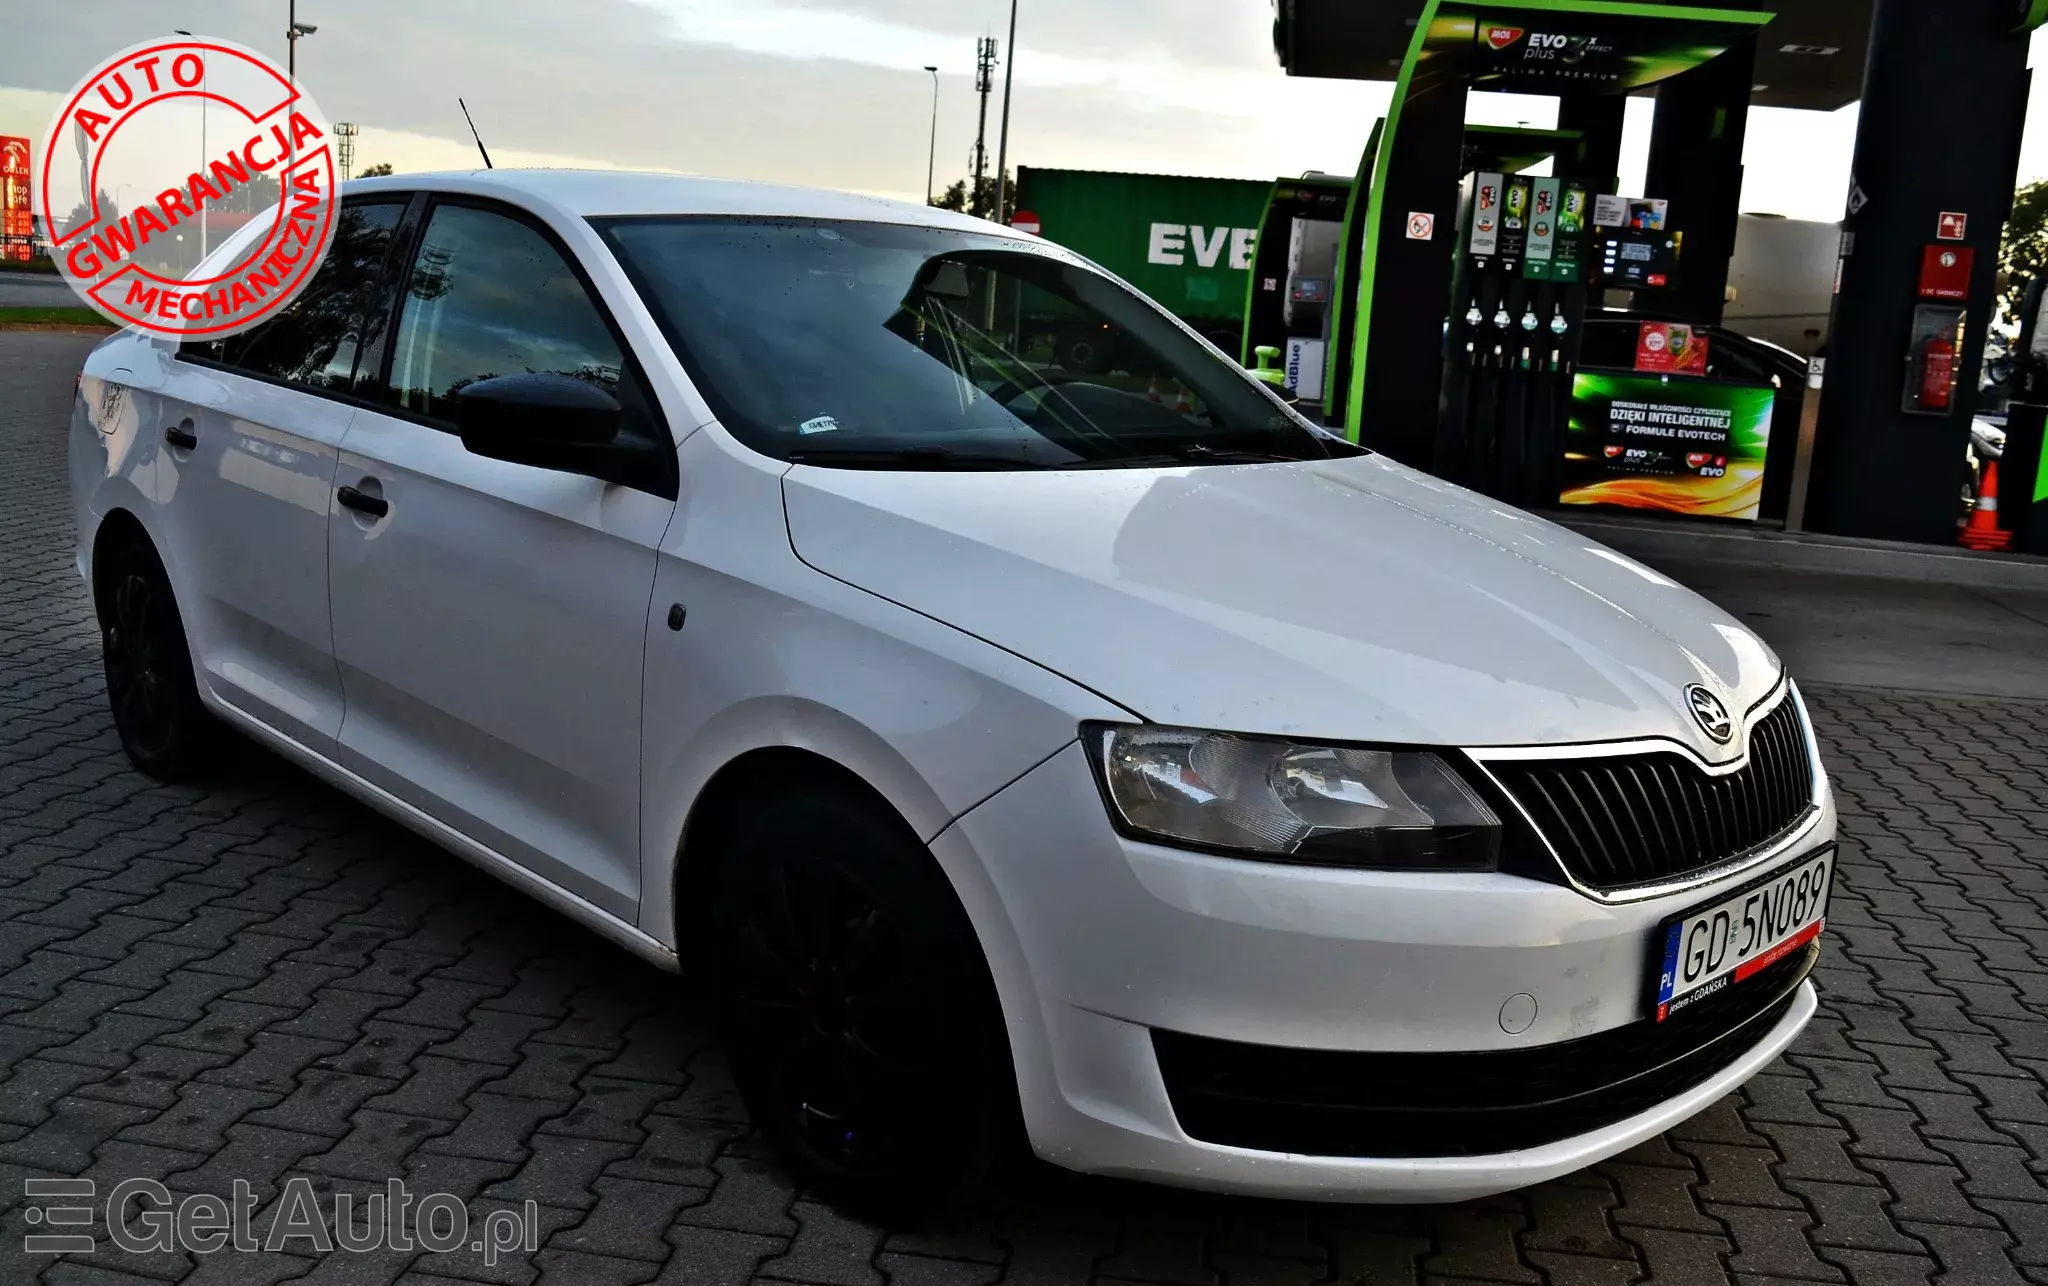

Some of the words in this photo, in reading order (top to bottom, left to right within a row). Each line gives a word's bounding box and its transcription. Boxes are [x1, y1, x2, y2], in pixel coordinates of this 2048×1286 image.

[1490, 29, 1511, 40] MOL
[1528, 32, 1568, 49] EVO
[1523, 46, 1556, 60] plus
[1492, 65, 1545, 76] PALIWA
[1555, 70, 1619, 81] PREMIUM
[1610, 408, 1646, 424] DZIĘKI
[1648, 411, 1731, 429] INTELIGENTNEJ
[1626, 425, 1675, 437] FORMULE
[1678, 429, 1726, 442] EVOTECH
[1626, 449, 1647, 458] EVO
[1700, 467, 1724, 477] EVO
[1684, 909, 1730, 983] GD
[1660, 971, 1673, 992] PL
[1668, 997, 1690, 1015] jestem
[1694, 976, 1728, 1001] GDAŃSKA
